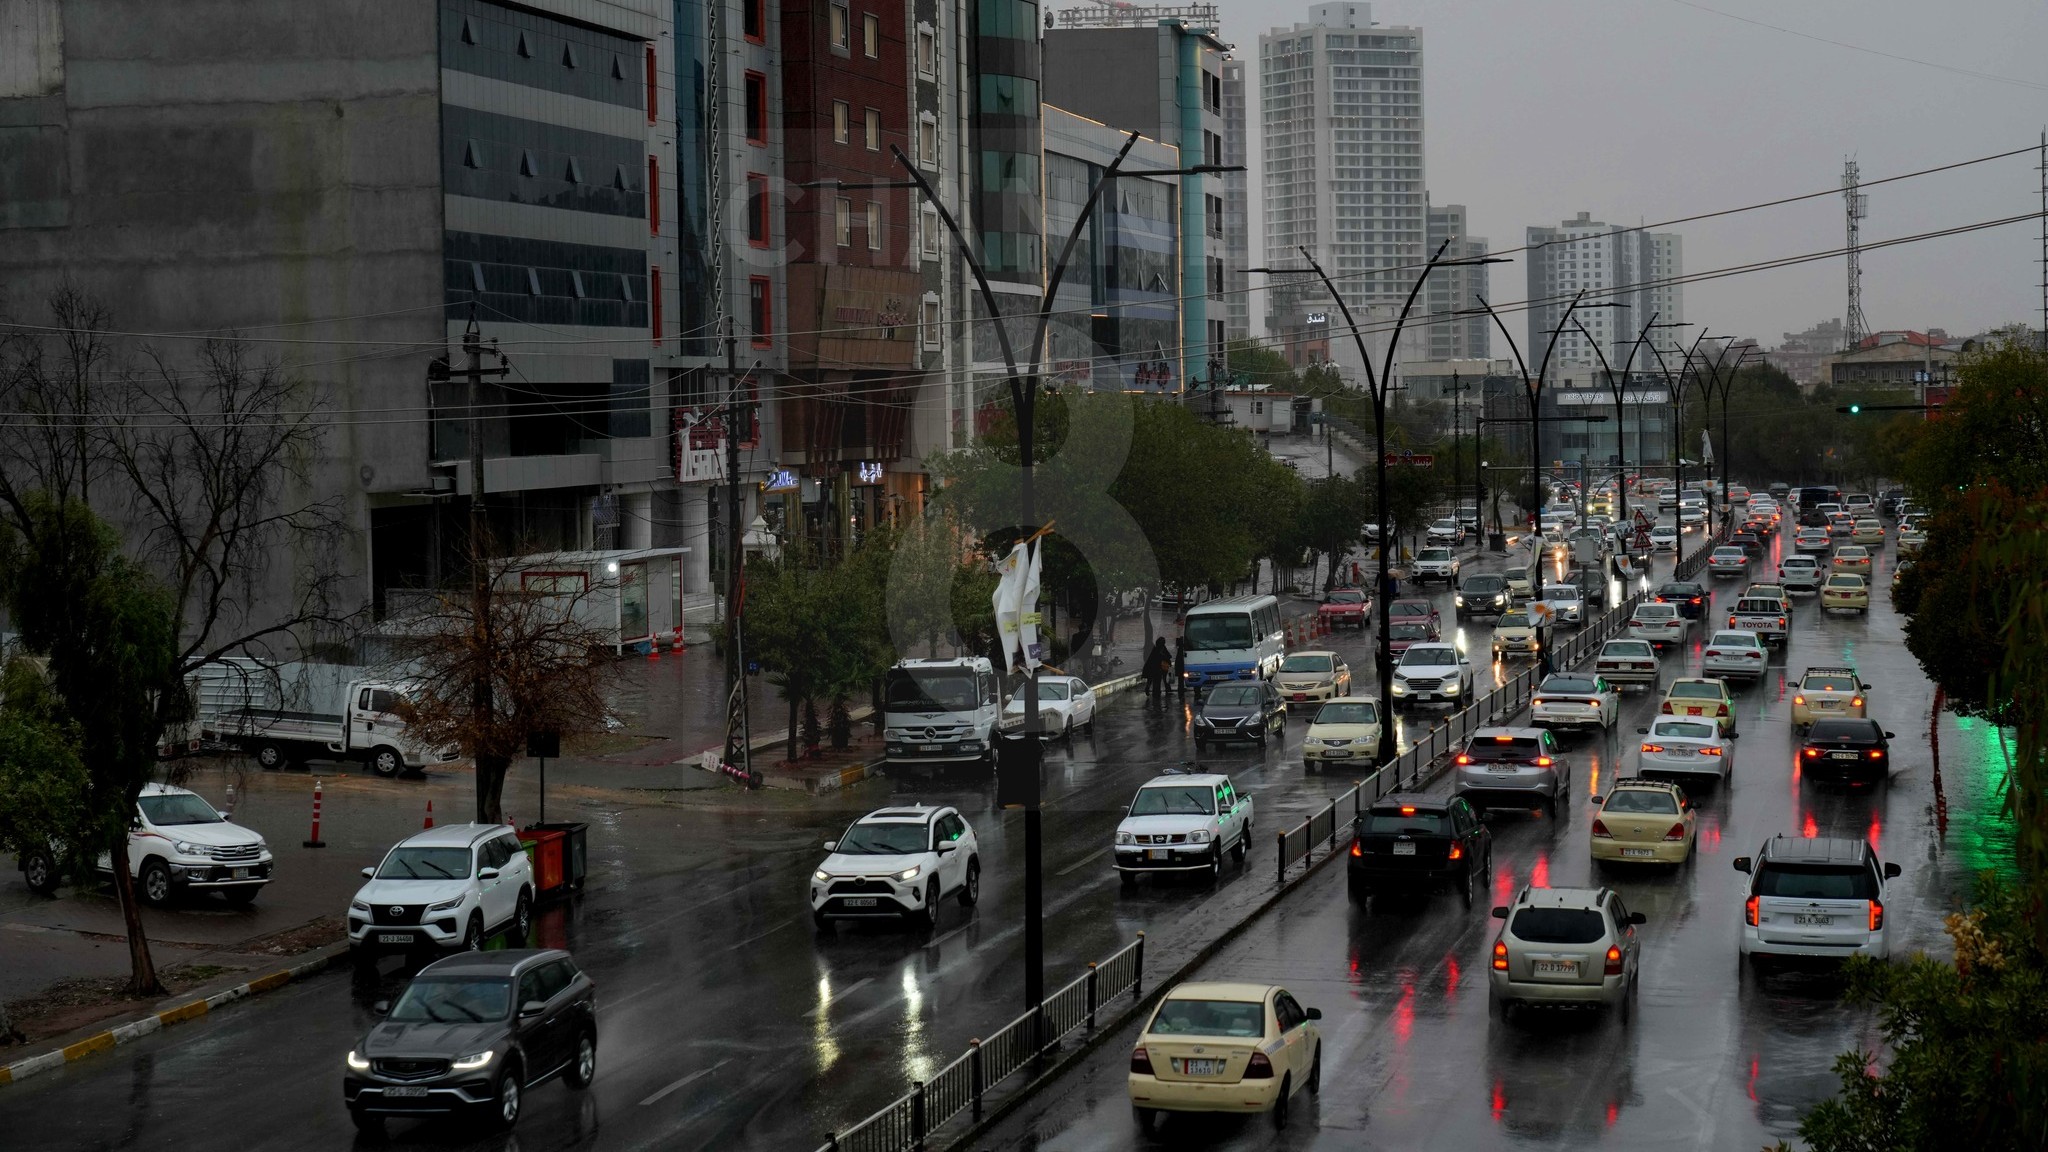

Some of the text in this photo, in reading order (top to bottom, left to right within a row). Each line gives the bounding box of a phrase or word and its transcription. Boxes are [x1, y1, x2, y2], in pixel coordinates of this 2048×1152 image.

[1306, 312, 1325, 324] فندق
[1741, 621, 1773, 629] TOYOTA
[1540, 963, 1548, 971] 22
